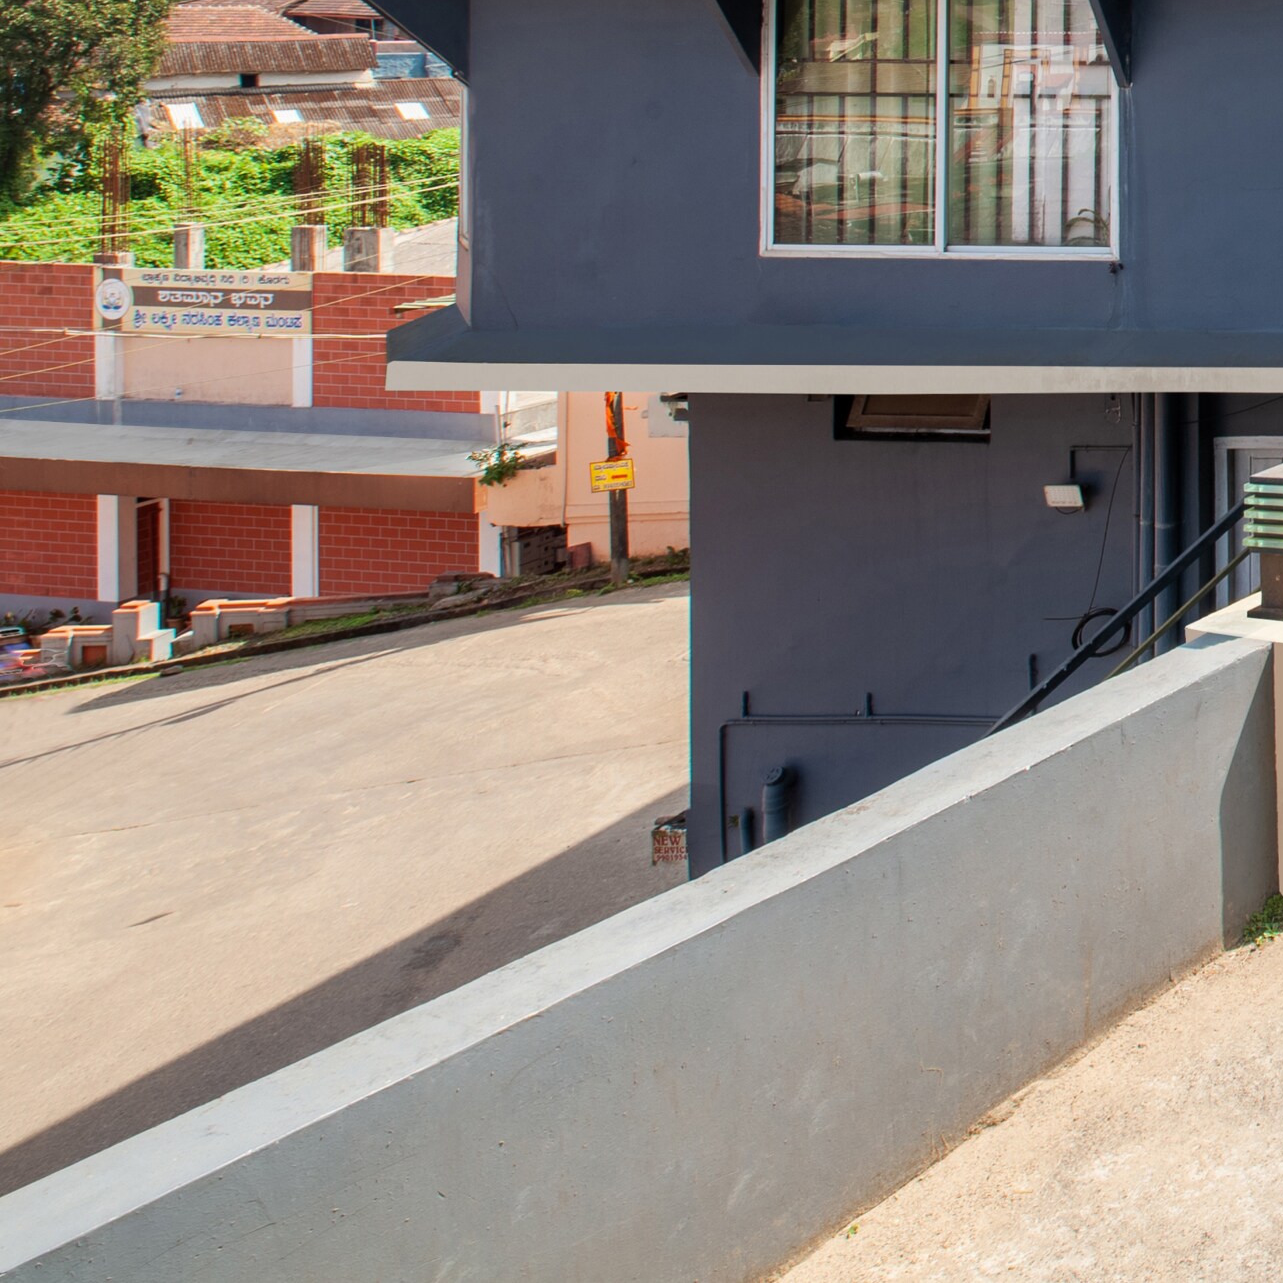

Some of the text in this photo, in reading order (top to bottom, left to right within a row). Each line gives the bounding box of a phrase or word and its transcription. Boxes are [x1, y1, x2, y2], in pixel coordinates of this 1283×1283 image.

[157, 290, 275, 309] ಶತಮಾನ ಭವನ
[133, 309, 147, 329] ಶ್ರೀ
[653, 835, 681, 846] NEW
[654, 846, 687, 855] SERVIC
